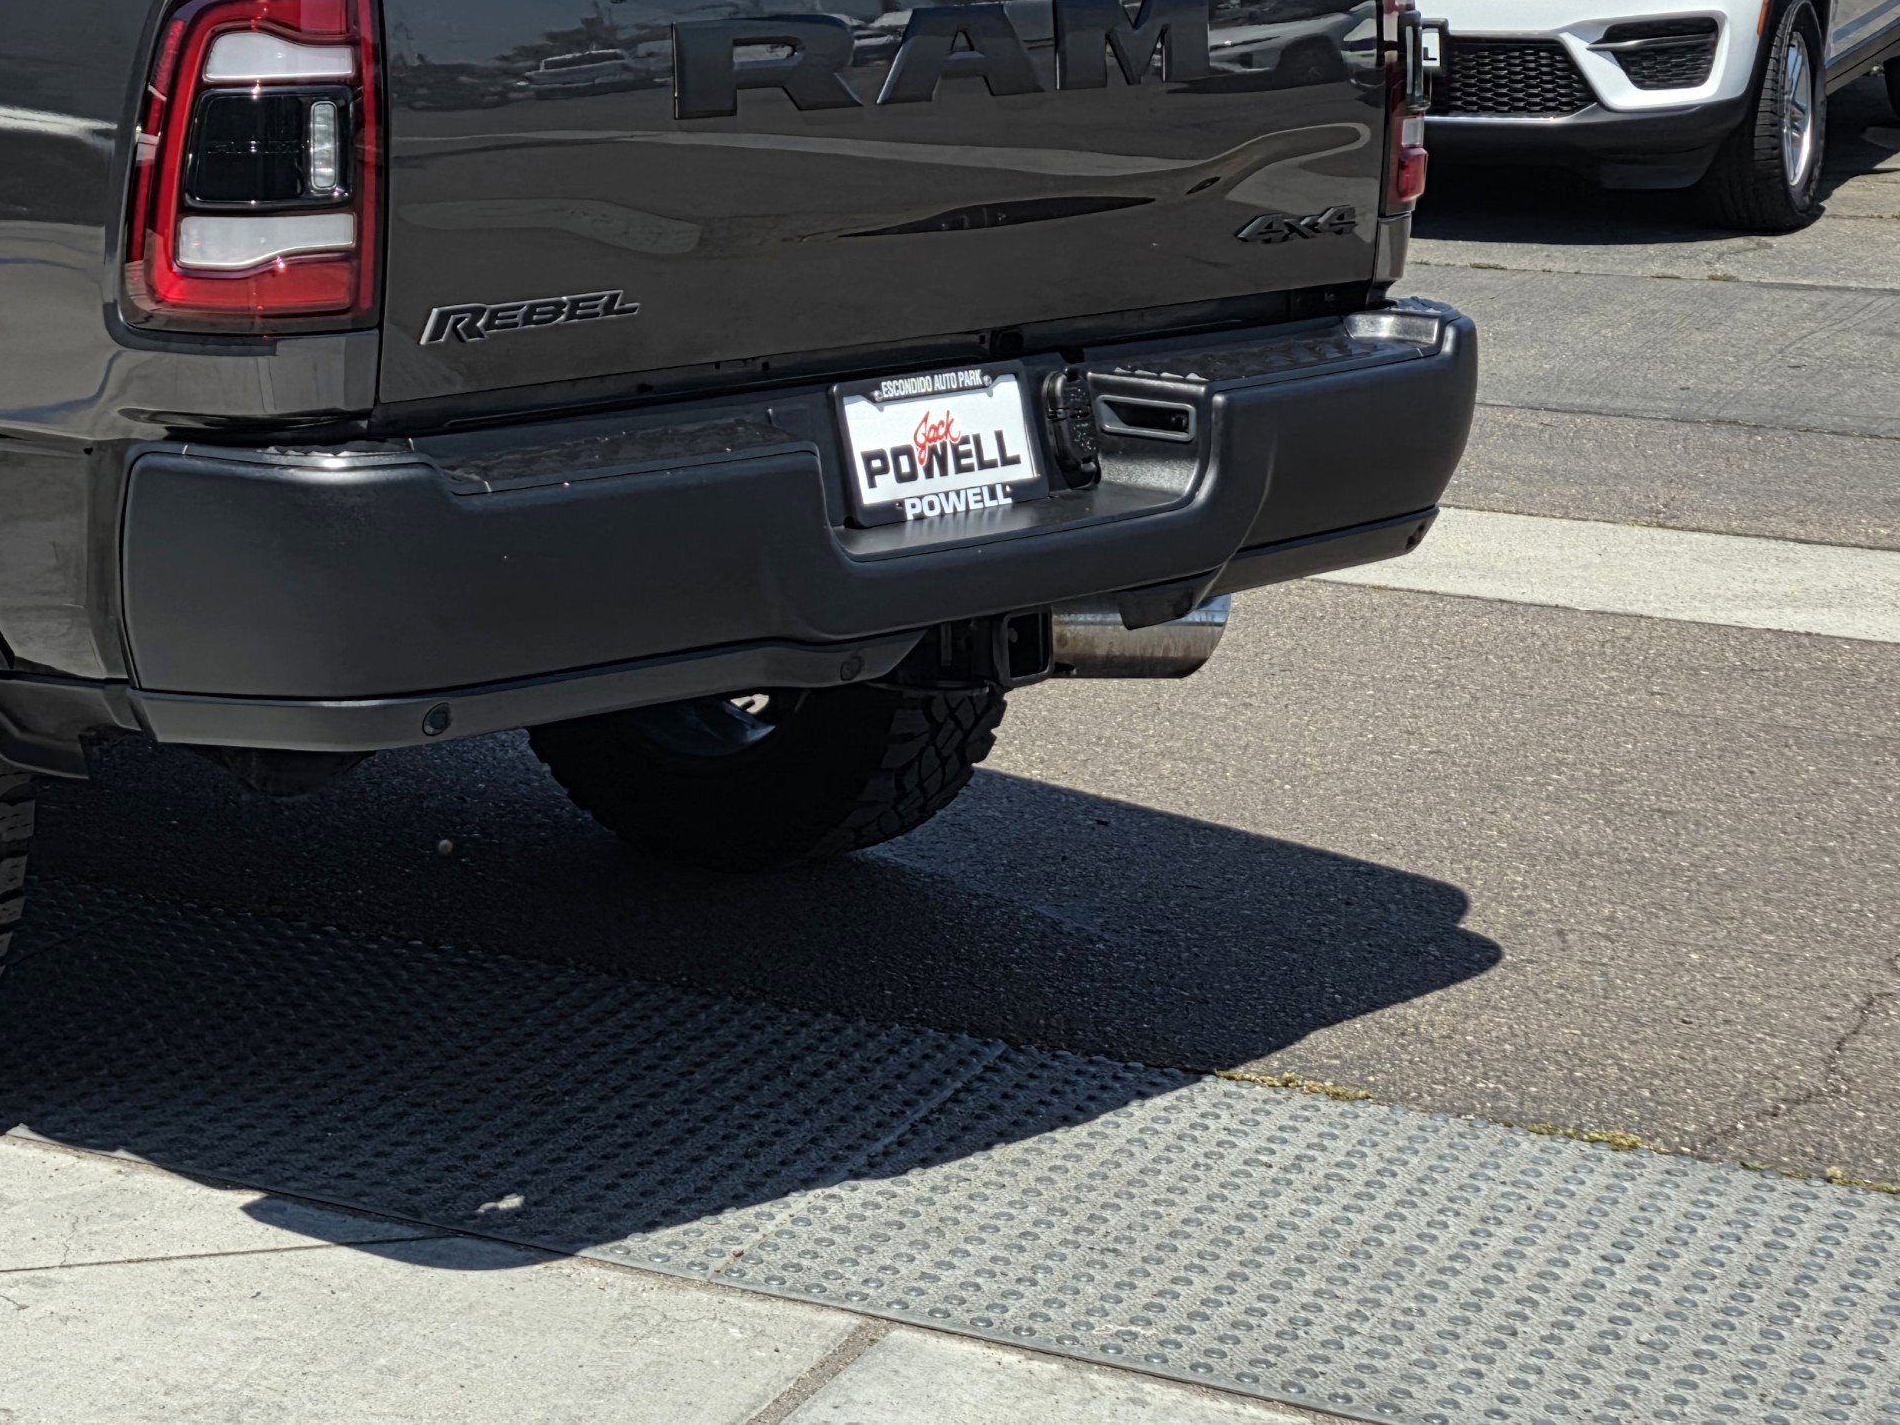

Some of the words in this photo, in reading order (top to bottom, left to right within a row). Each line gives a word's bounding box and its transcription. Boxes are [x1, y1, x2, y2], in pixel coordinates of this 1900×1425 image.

[418, 289, 642, 345] REBEL
[881, 375, 933, 398] ESCONDIDO
[934, 371, 958, 391] AUTO
[957, 369, 983, 388] PARK
[860, 429, 1022, 489] POWELL
[913, 410, 962, 466] Jack
[903, 483, 1013, 521] POWELL
